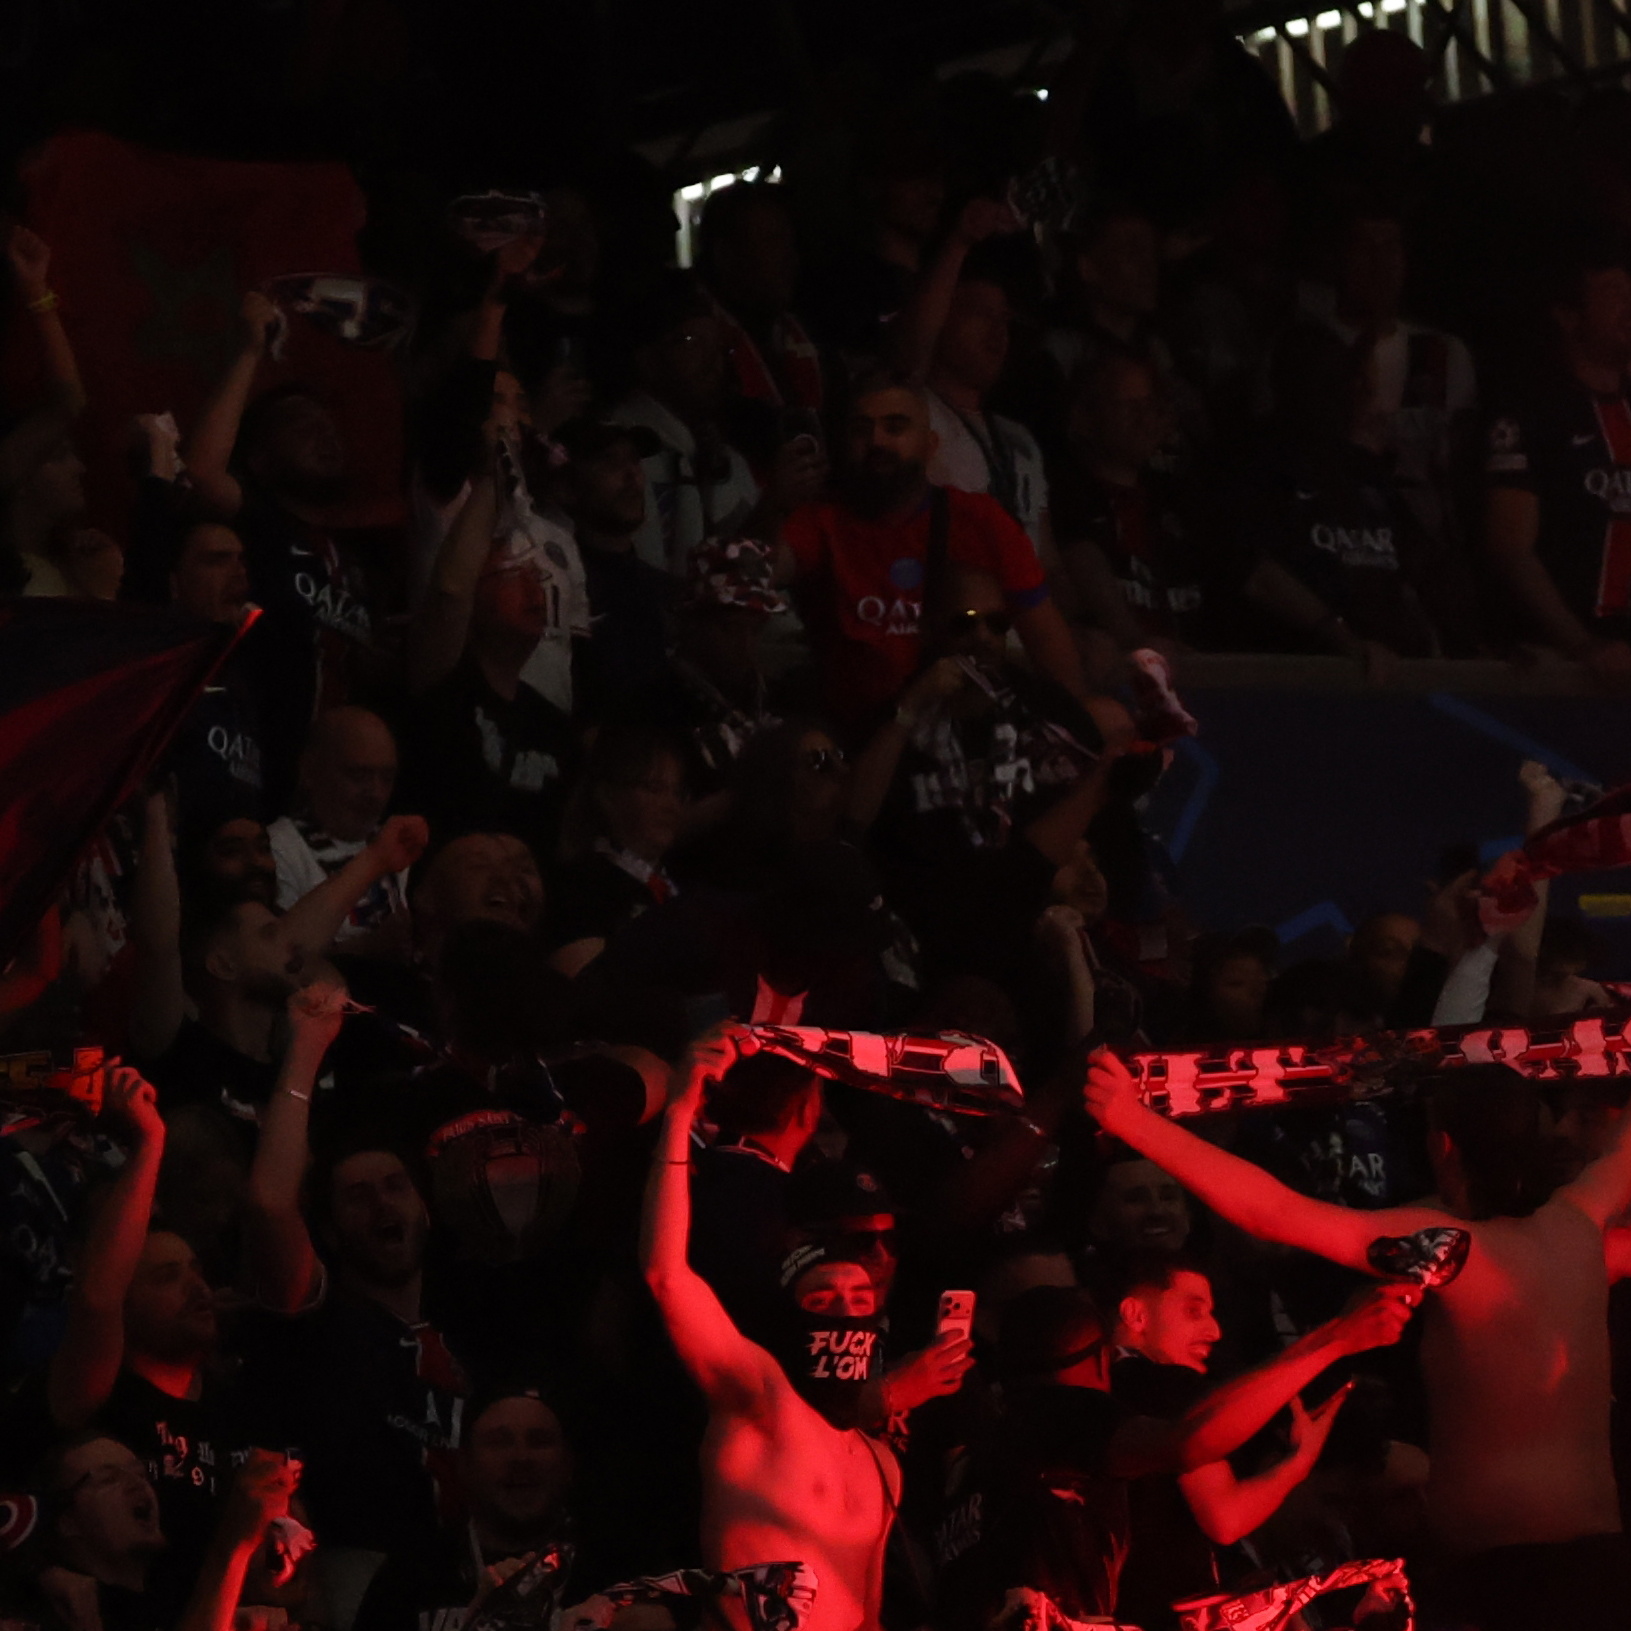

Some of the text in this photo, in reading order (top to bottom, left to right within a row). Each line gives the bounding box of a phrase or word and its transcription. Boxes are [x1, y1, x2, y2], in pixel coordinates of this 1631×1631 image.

[856, 596, 923, 626] QAT
[808, 1330, 878, 1358] FUCK
[812, 1355, 872, 1382] L'OM
